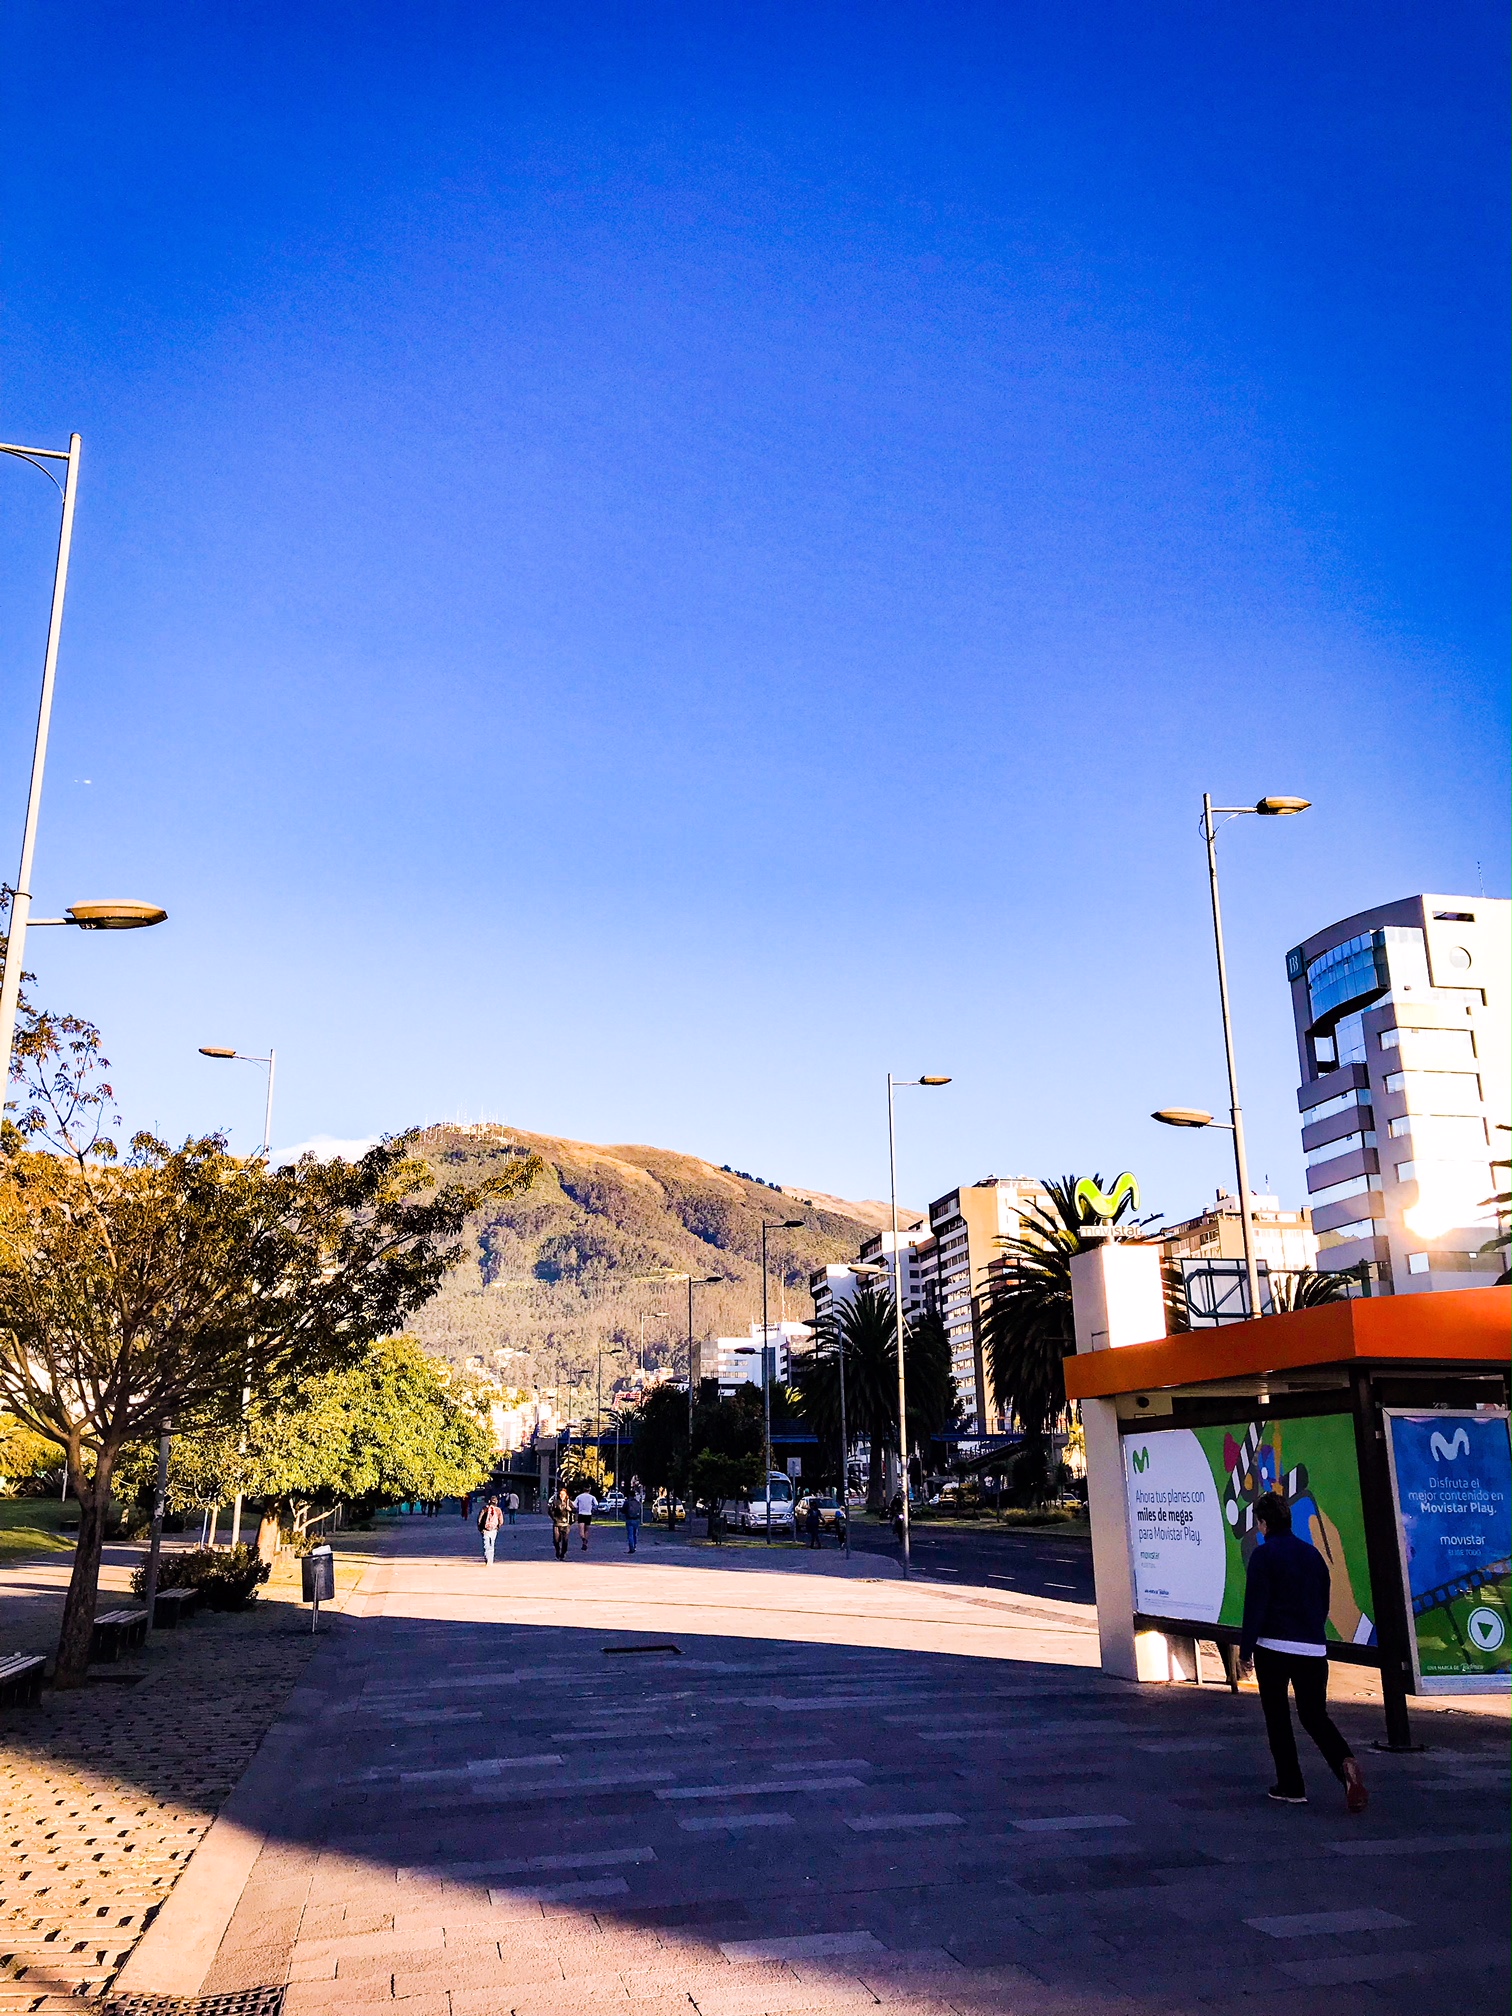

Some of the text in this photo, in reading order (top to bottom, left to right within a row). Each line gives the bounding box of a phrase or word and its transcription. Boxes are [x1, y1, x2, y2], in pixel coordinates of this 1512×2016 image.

[1080, 1226, 1141, 1236] movistar
[1429, 1477, 1480, 1488] Disfruta el
[1135, 1489, 1206, 1506] Ahora tus planes con
[1408, 1490, 1504, 1504] mejor contenido en
[1420, 1502, 1497, 1516] Movistar Play.
[1137, 1507, 1194, 1526] miles de megas
[1138, 1526, 1202, 1546] para Movistar Play.
[1439, 1534, 1486, 1545] movistar
